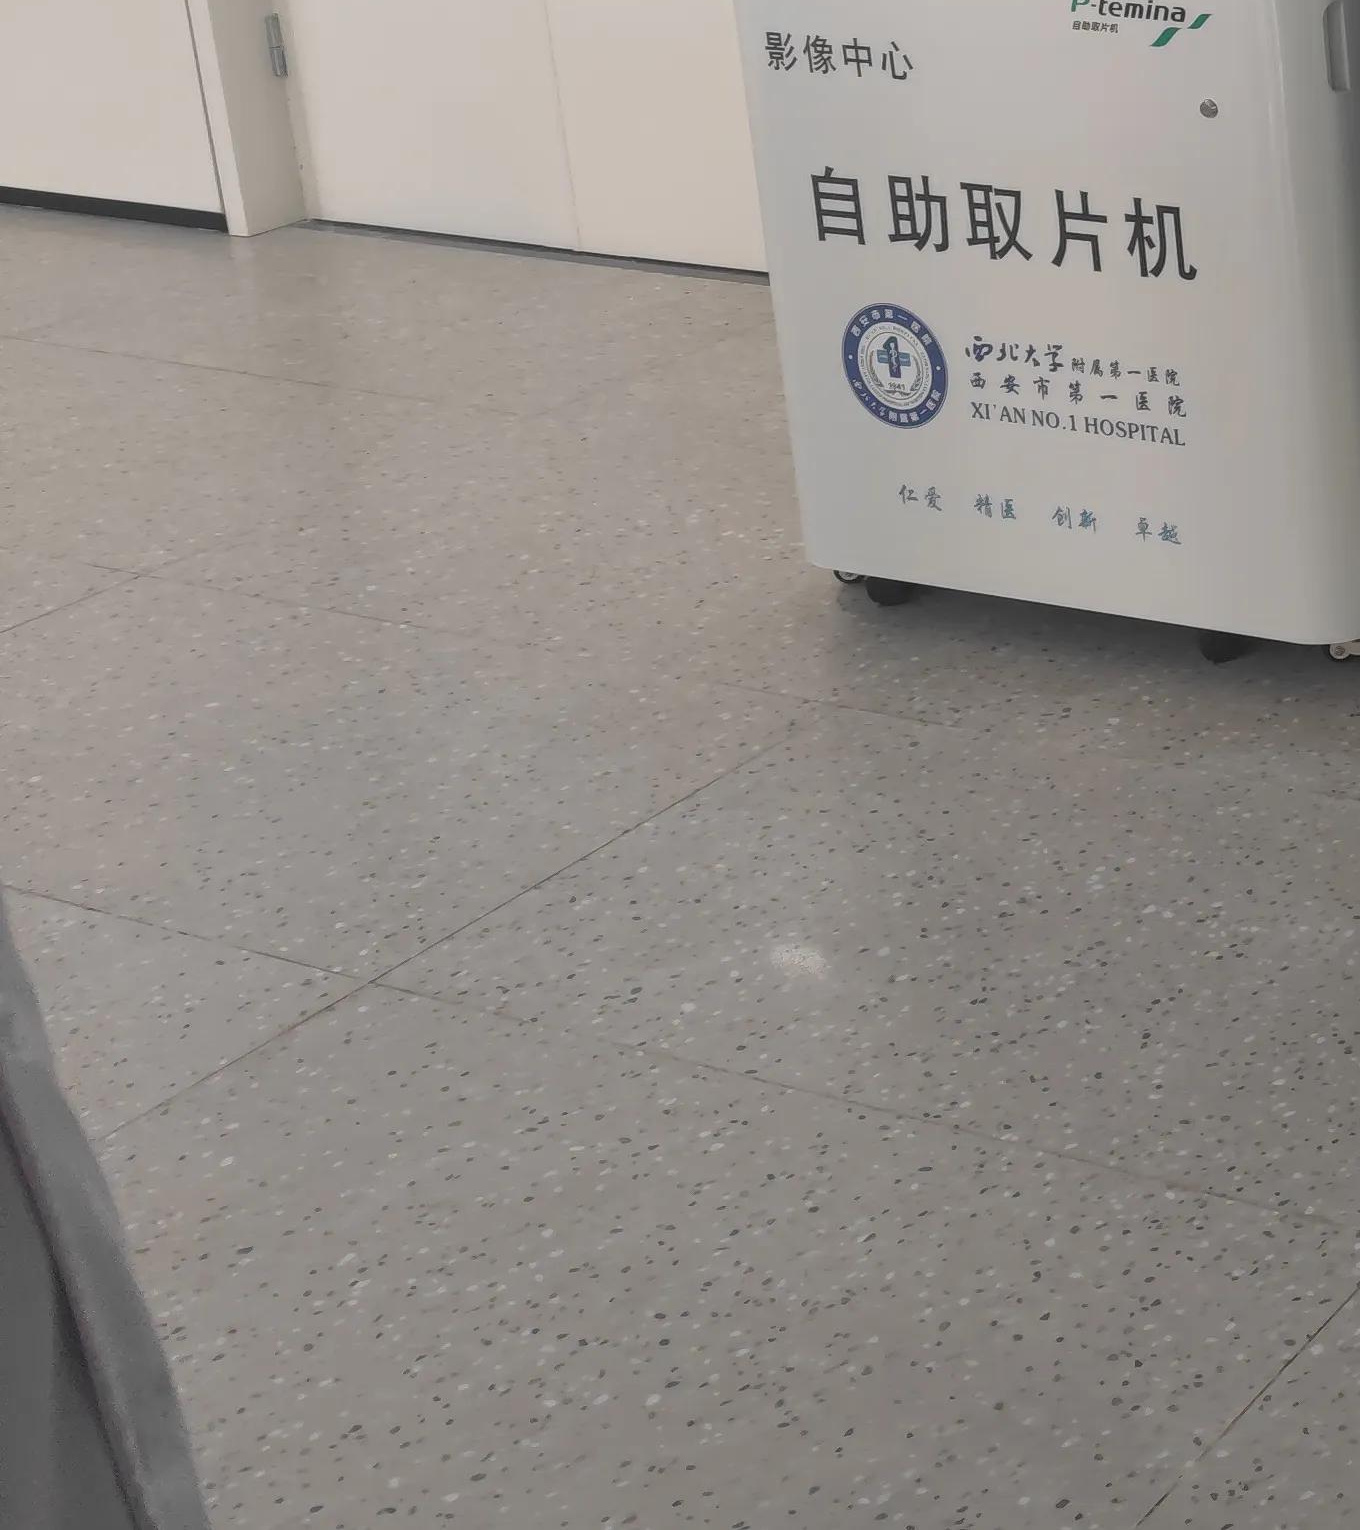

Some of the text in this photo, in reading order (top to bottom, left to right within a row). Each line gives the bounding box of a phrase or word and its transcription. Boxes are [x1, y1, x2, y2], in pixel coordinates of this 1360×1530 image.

[765, 31, 913, 81] 影像中心
[810, 165, 1198, 281] 自助取片机
[970, 372, 1187, 417] 西安市第一医院
[1031, 409, 1076, 432] NO.1
[1084, 416, 1186, 447] HOSPITAL
[973, 493, 1017, 520] 精医
[1051, 506, 1097, 533] 创新
[1134, 517, 1182, 545] 卓越
